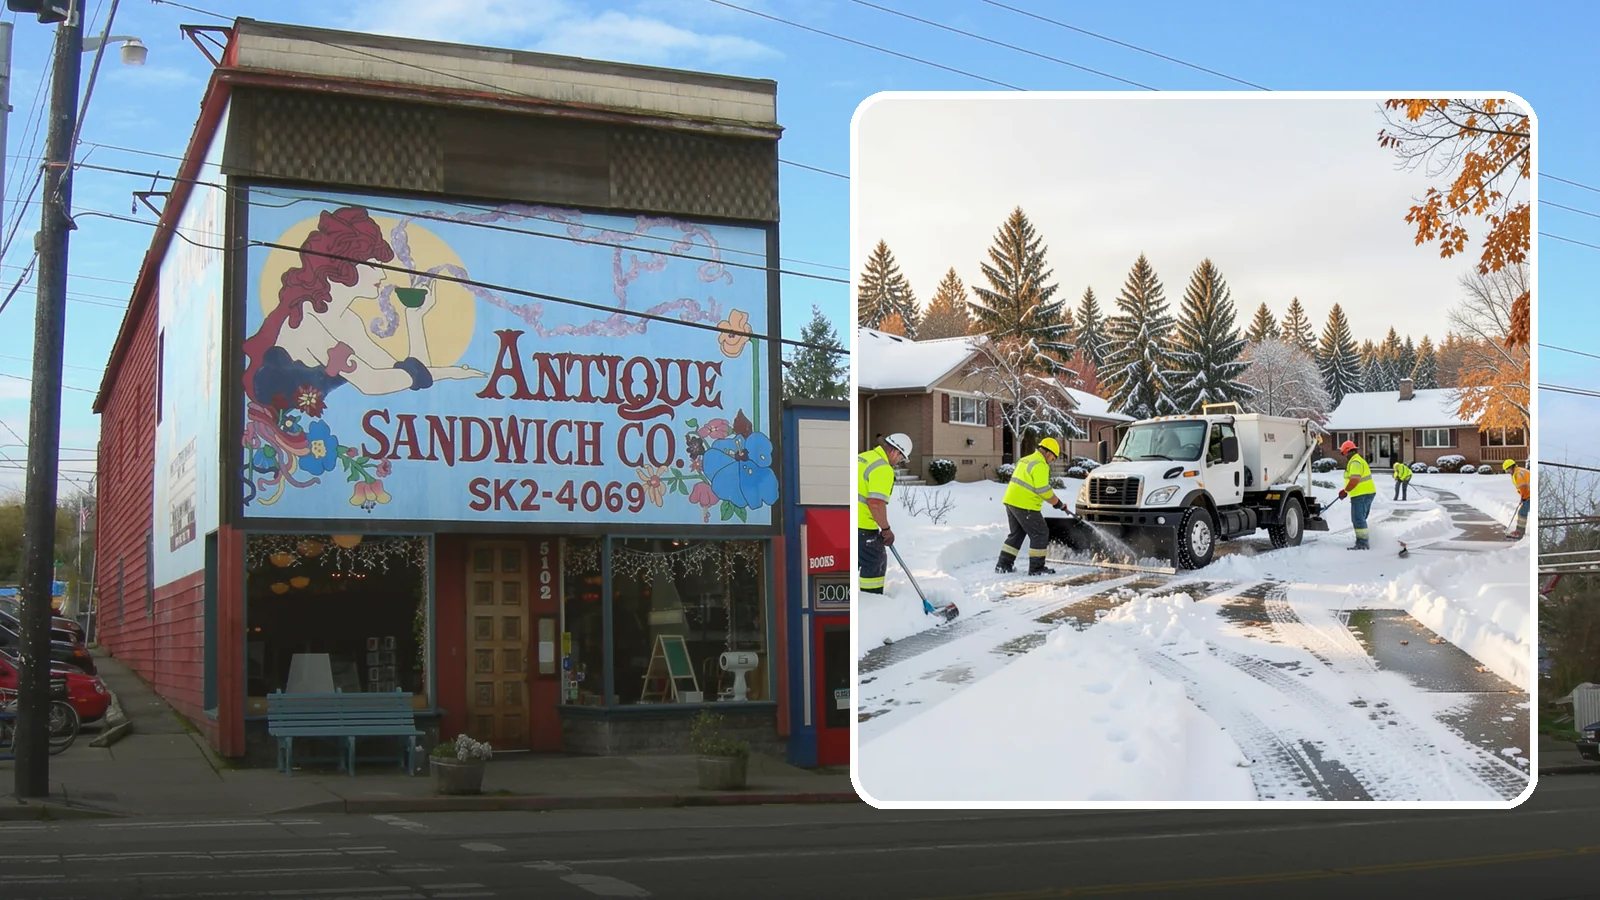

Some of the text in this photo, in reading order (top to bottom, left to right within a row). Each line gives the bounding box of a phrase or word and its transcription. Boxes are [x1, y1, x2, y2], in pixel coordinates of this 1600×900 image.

[476, 329, 724, 420] ANTIQUE
[361, 409, 685, 469] SANDWICH CO.
[468, 477, 646, 513] SK2-4069
[540, 541, 551, 600] 5102
[809, 555, 835, 569] BOOKS
